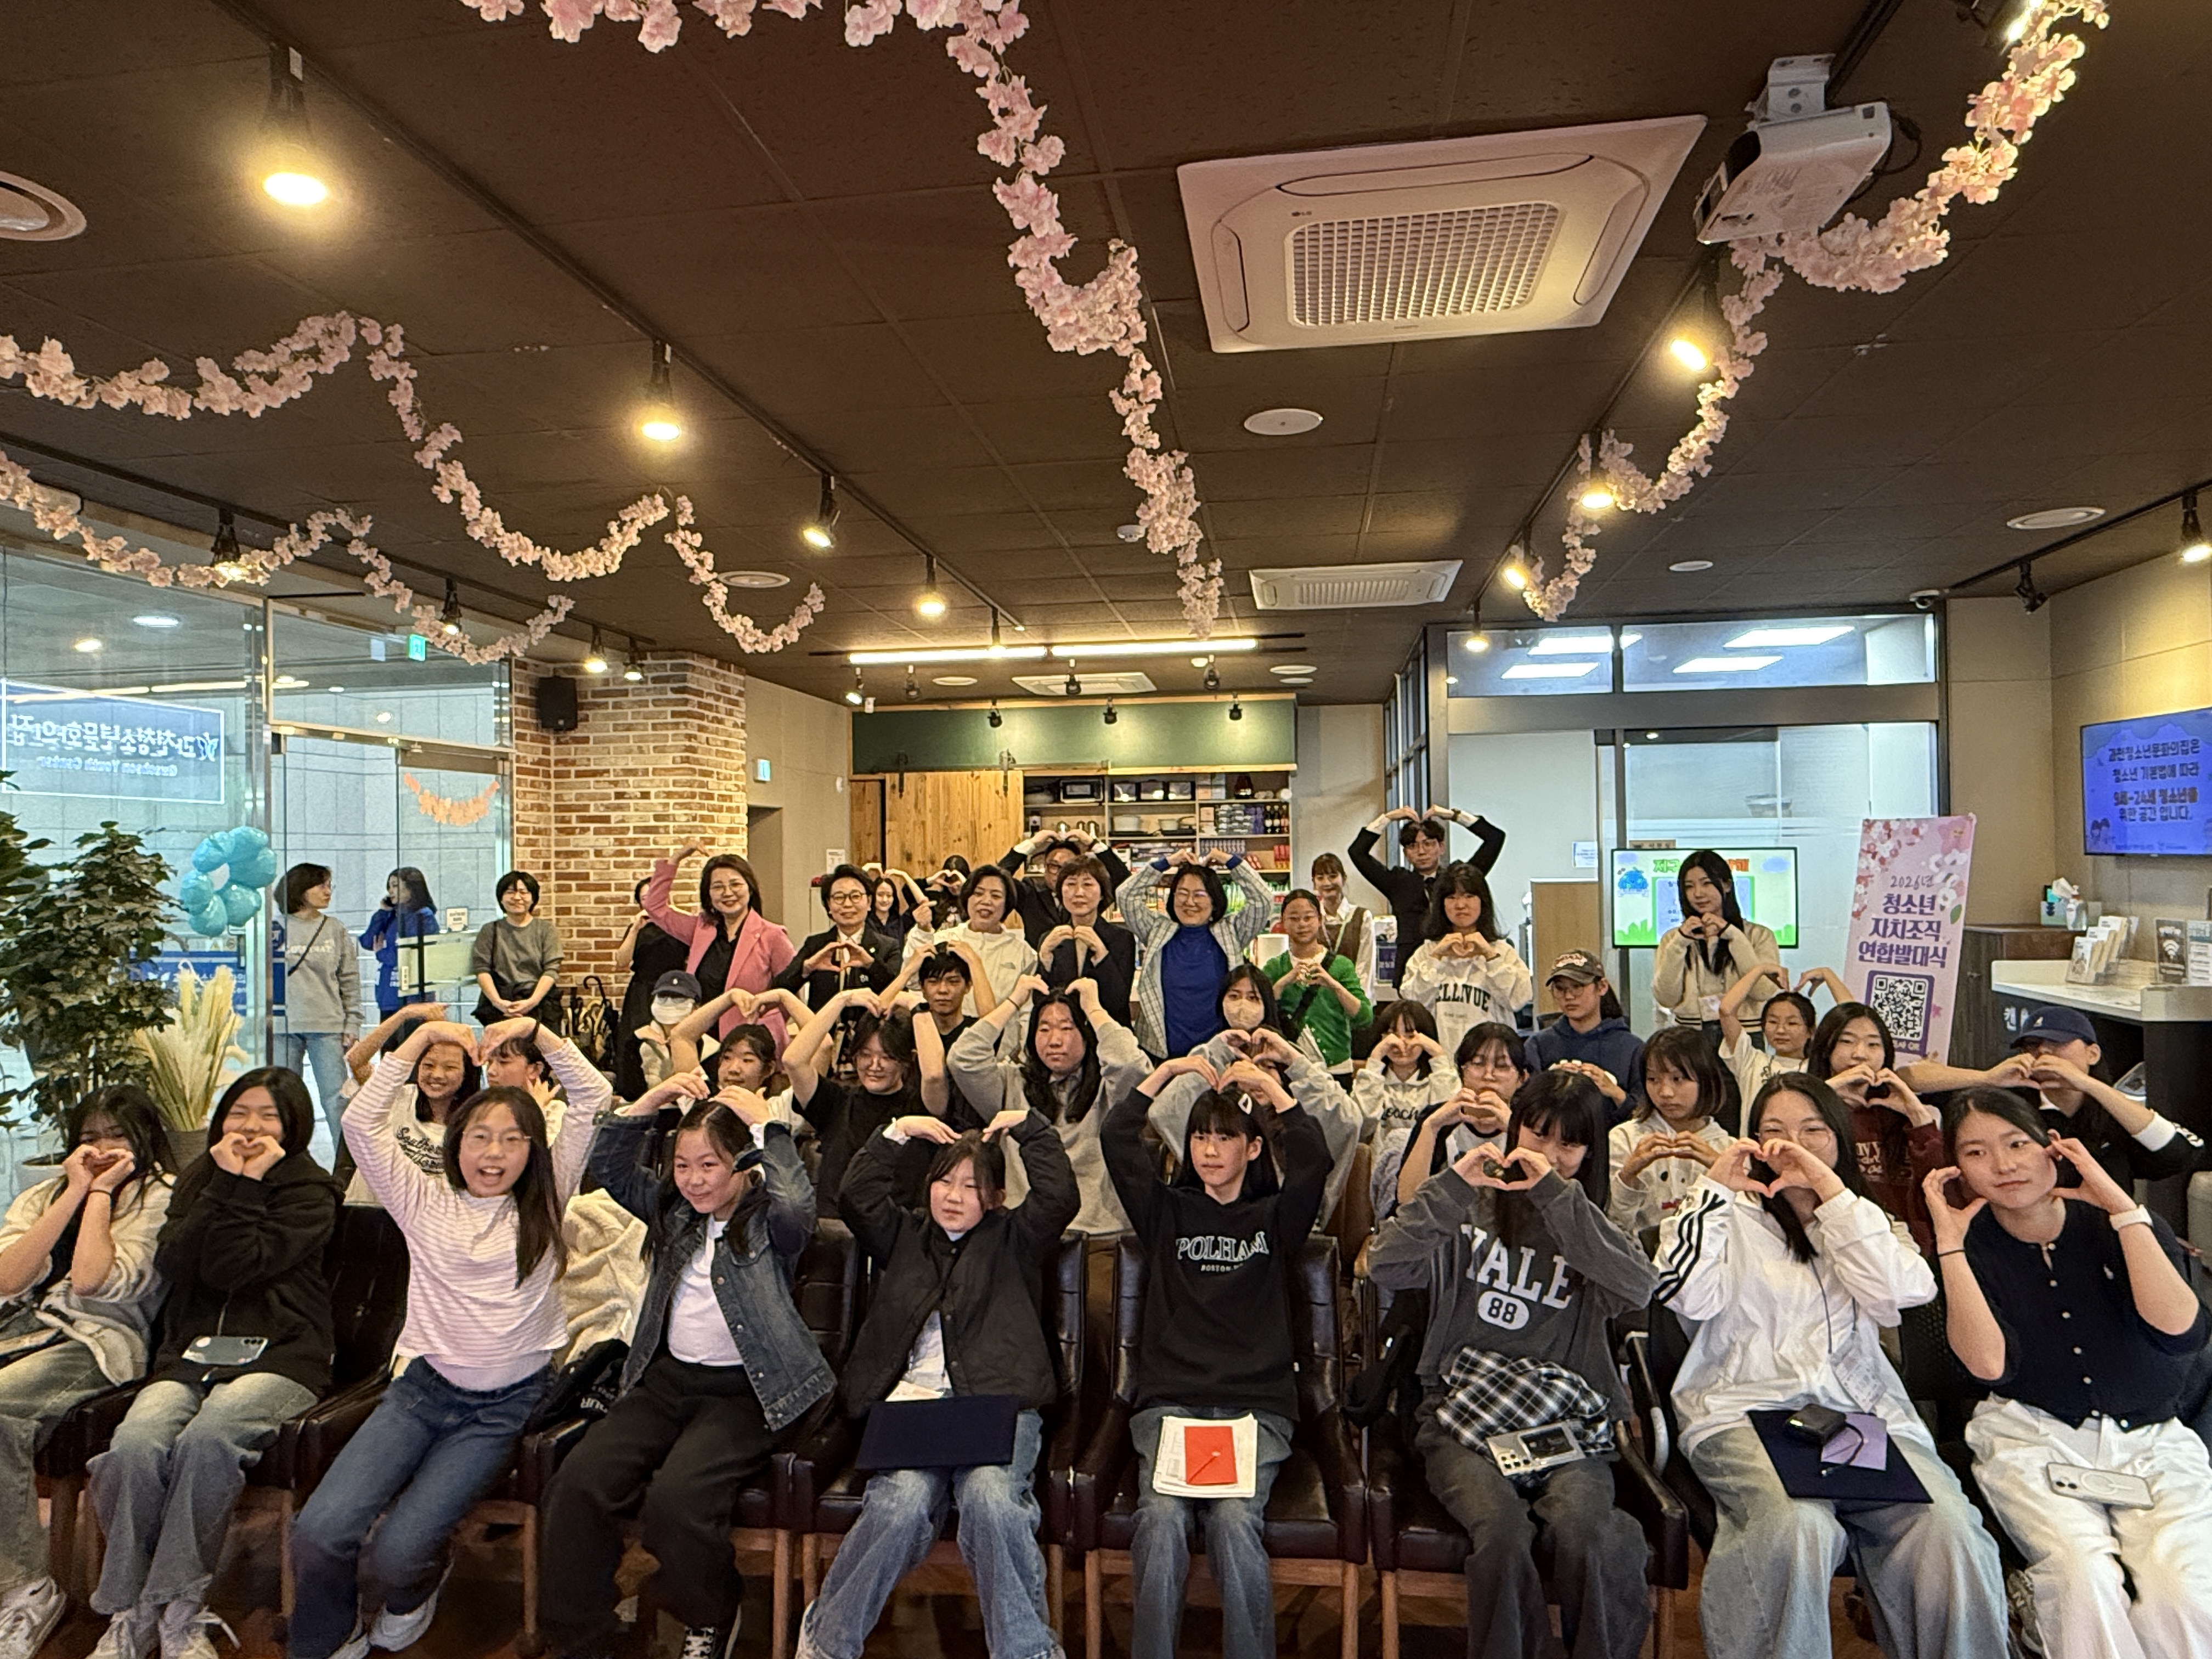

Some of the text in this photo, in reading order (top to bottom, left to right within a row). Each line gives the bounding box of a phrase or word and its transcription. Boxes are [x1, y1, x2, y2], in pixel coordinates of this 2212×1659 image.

[1883, 894, 1937, 916] 청소년
[1869, 917, 1942, 941] 자치조직
[1859, 940, 1948, 968] 연합발대식
[1175, 1231, 1269, 1262] POLHAM
[1460, 1223, 1573, 1310] YALE
[1487, 1297, 1518, 1324] 88
